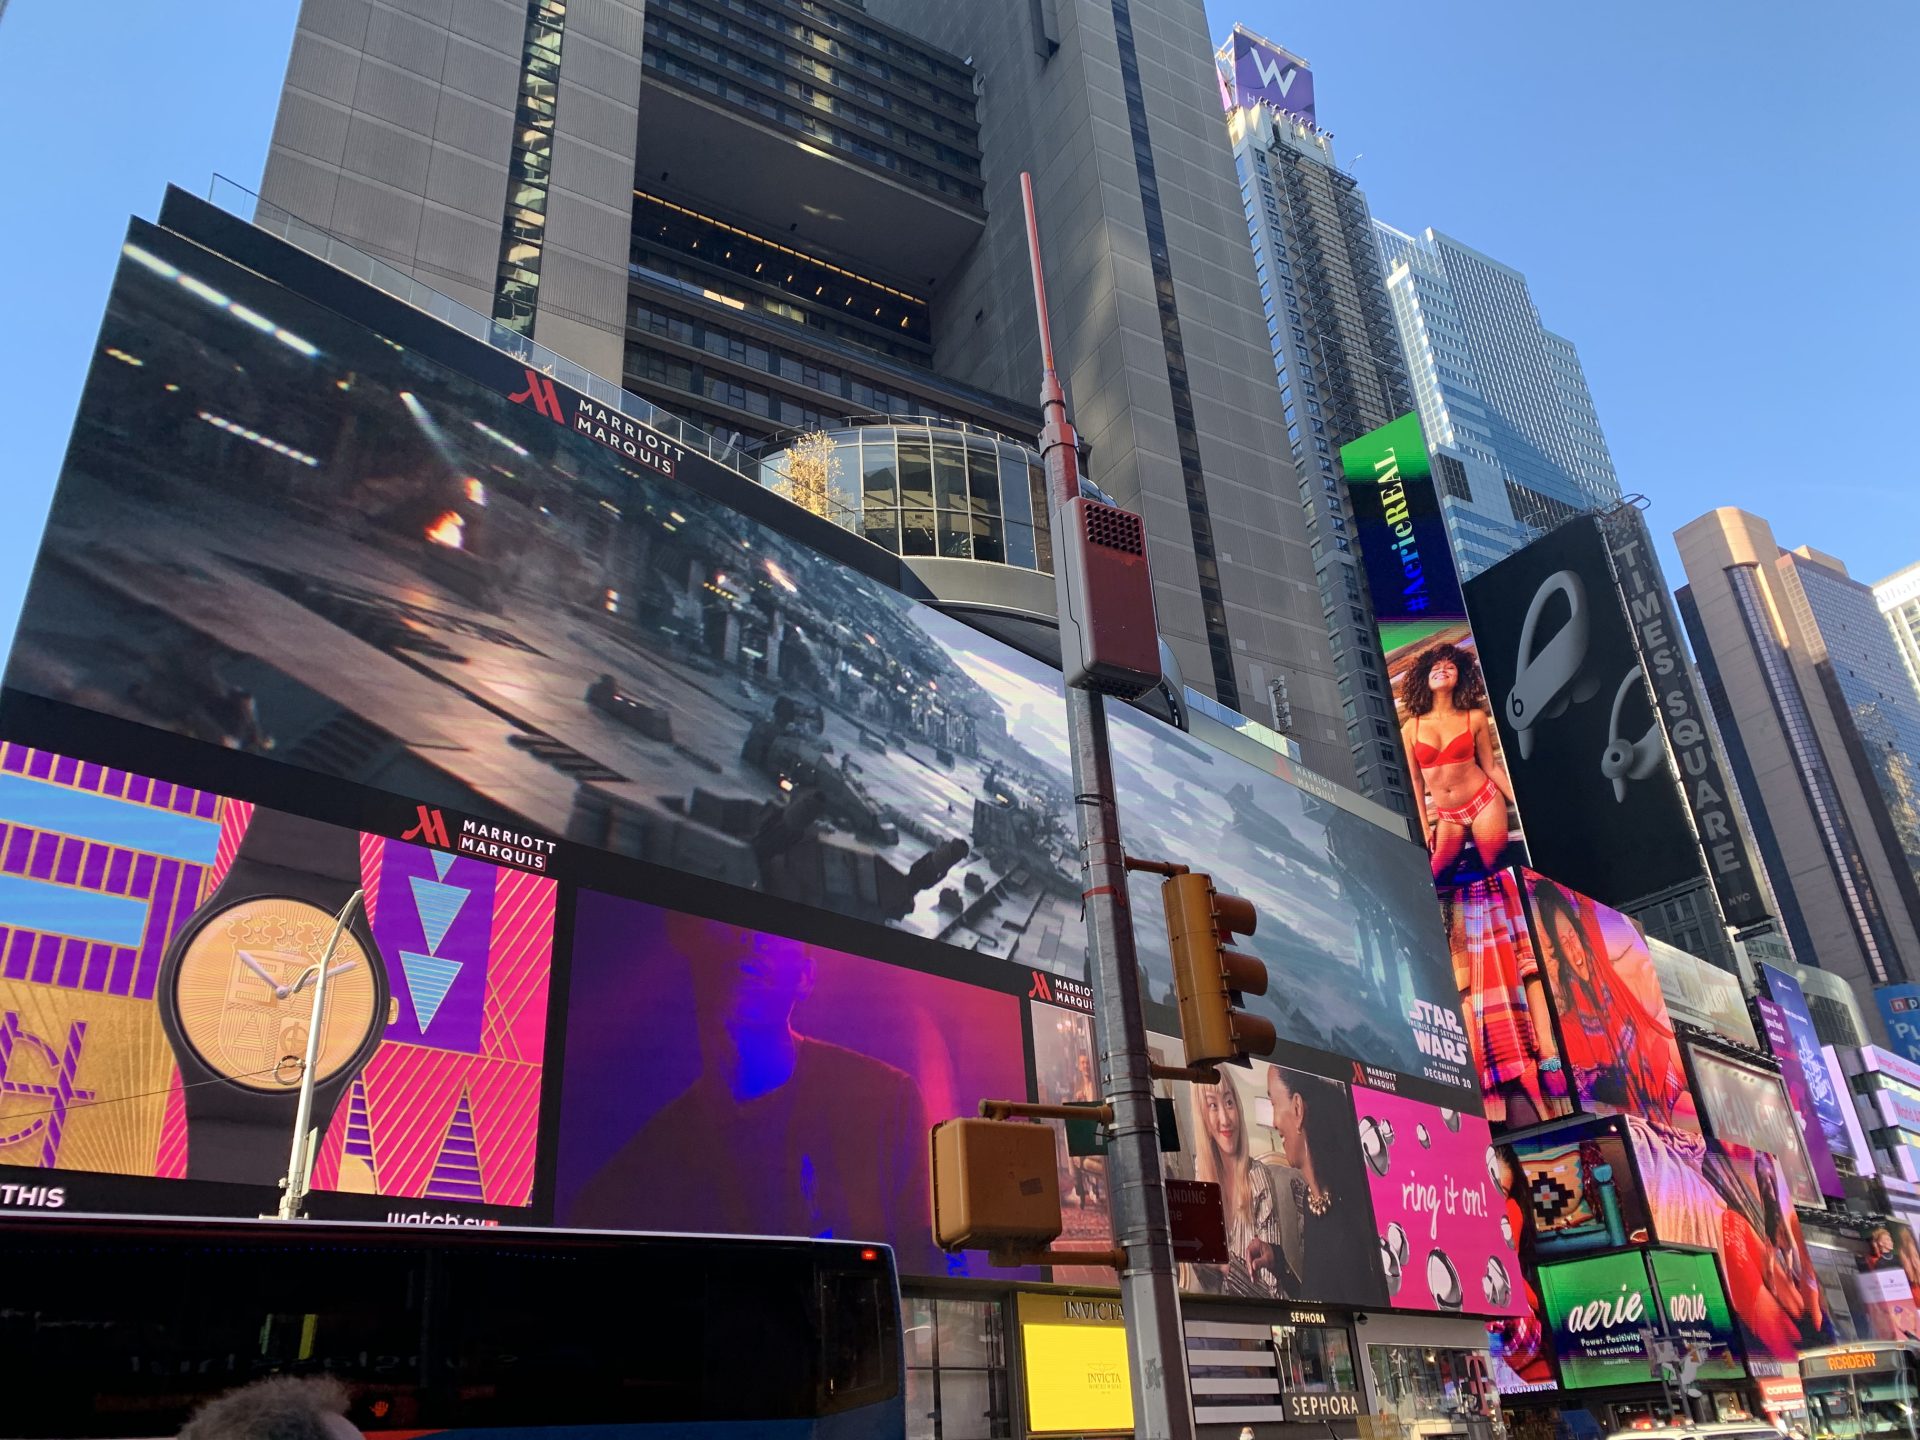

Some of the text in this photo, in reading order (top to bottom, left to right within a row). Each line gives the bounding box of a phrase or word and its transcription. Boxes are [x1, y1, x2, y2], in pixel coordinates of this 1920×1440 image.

[1250, 46, 1297, 98] W
[579, 399, 685, 463] MARRIOTT
[577, 417, 672, 475] MARQUIS
[1374, 446, 1430, 612] #AerieREAL
[1614, 539, 1741, 875] TIMES SQUARE
[463, 819, 557, 855] MARRIOTT
[461, 836, 543, 869] MARQUIS
[1727, 892, 1751, 907] NYC
[1055, 978, 1094, 997] MARRIO
[1056, 991, 1095, 1010] MARQUI
[1408, 998, 1464, 1035] STAR
[1412, 1027, 1467, 1066] WARS
[1440, 1029, 1469, 1045] SKYWALKER
[1366, 1066, 1397, 1082] MARRIOTT
[1368, 1076, 1396, 1091] MARQUIS
[1423, 1066, 1472, 1089] DECEMBER 20
[1, 1184, 65, 1208] THIS
[1167, 1189, 1207, 1204] ANDING
[1402, 1169, 1488, 1240] ring it on!
[1063, 1300, 1125, 1321] INVICTA
[1568, 1283, 1644, 1333] aerie
[1670, 1283, 1707, 1323] aerie
[1290, 1311, 1326, 1324] SEPHORA
[1580, 1331, 1643, 1347] Power. Positivity.
[1586, 1344, 1643, 1357] No retouching.
[1828, 1351, 1877, 1371] ACADEMY
[1087, 1372, 1122, 1384] INVICTA
[1509, 1382, 1556, 1395] OUTFITTERS
[1291, 1395, 1360, 1417] SEPHORA
